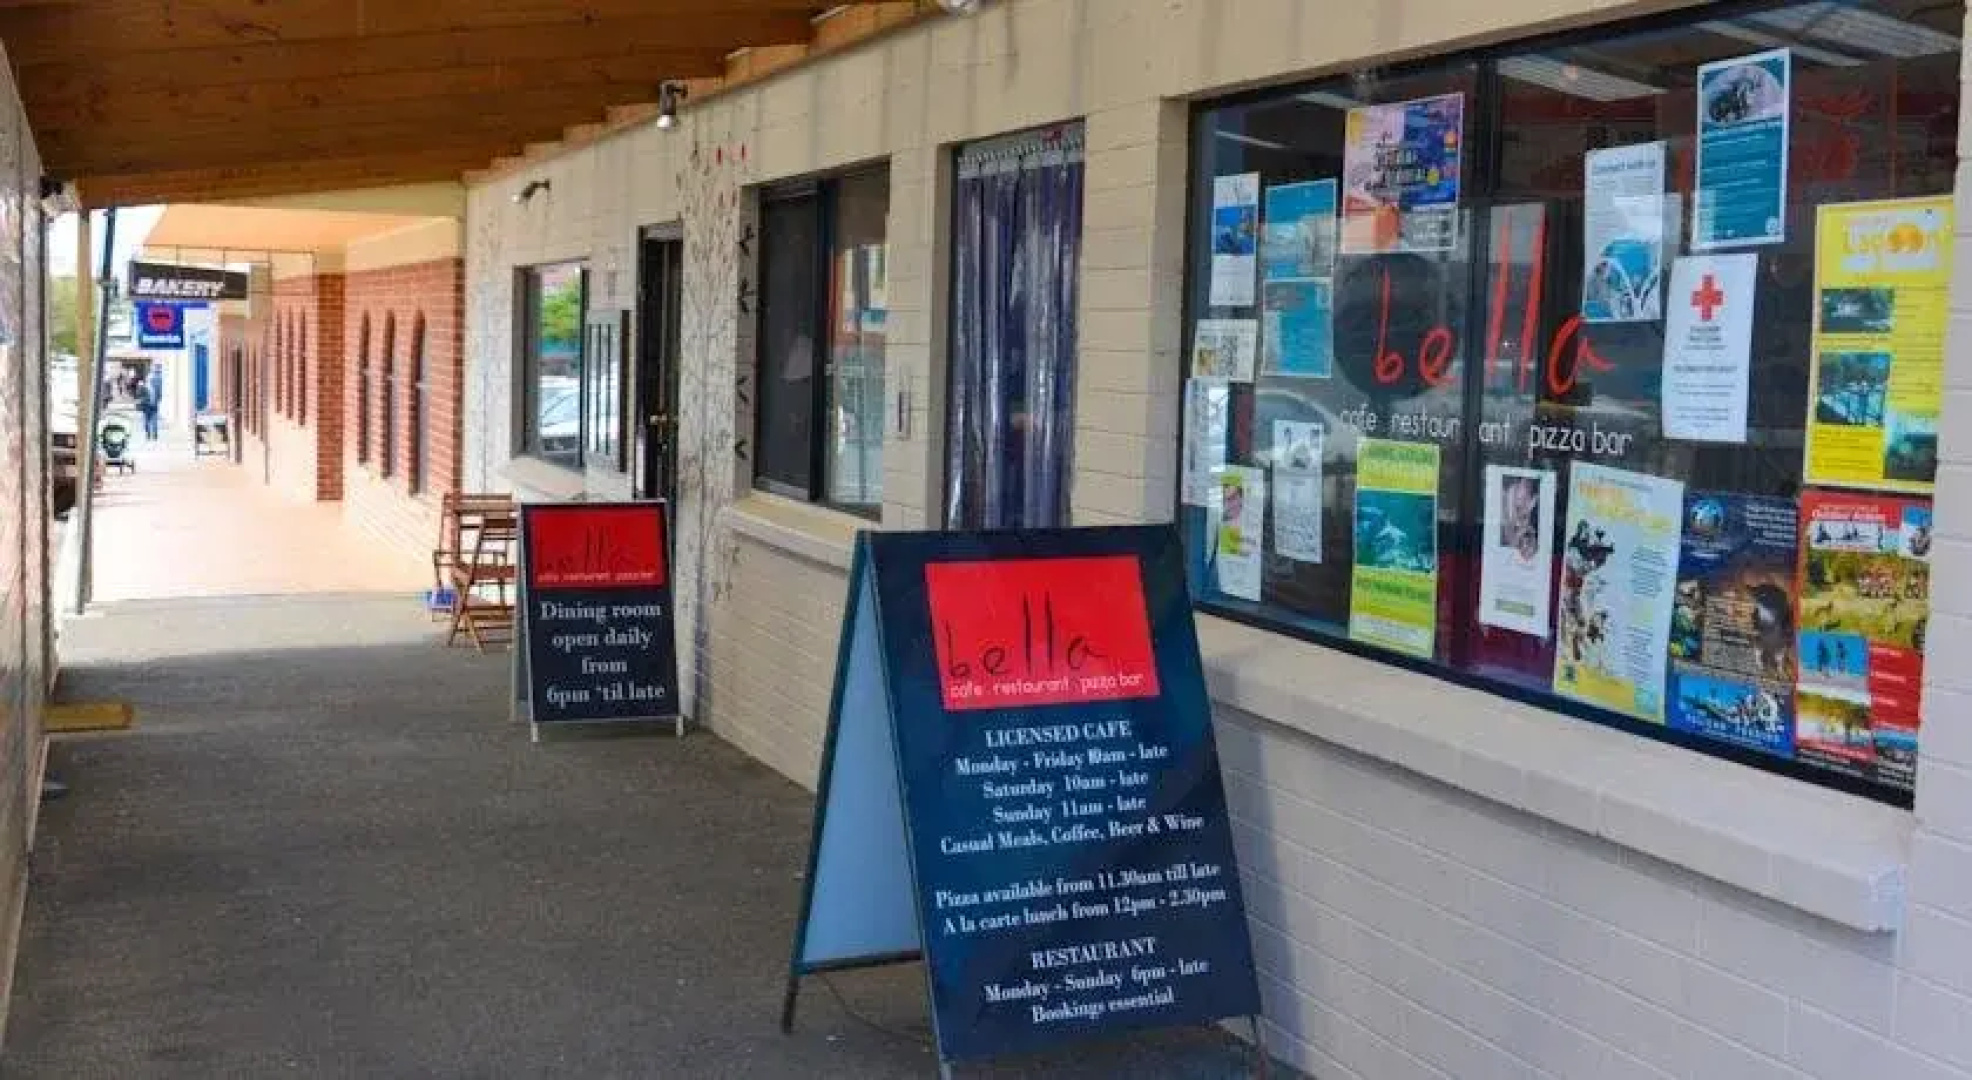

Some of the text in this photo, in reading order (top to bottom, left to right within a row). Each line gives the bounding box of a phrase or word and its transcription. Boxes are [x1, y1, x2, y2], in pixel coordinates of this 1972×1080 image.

[136, 277, 225, 297] BAKERY
[1373, 203, 1615, 396] bella
[1340, 405, 1377, 432] cafe
[1529, 423, 1584, 458] pizza
[1592, 422, 1633, 455] bar
[539, 602, 662, 624] Dining room
[552, 627, 653, 653] open daily
[946, 590, 1107, 677] bella
[581, 657, 628, 675] from
[546, 687, 590, 709] 6pm
[628, 681, 665, 700] late
[950, 682, 982, 699] cafe
[993, 677, 1069, 696] restaurant
[1119, 671, 1144, 687] bar
[985, 720, 1133, 748] LICENSED CAFE
[955, 755, 1018, 776] Monday
[1033, 750, 1083, 770] Friday
[1138, 743, 1168, 760] late
[983, 778, 1053, 799] Saturday
[1065, 774, 1106, 791] 10am
[1119, 770, 1149, 786] late
[993, 803, 1051, 824] Sunday
[1061, 800, 1104, 817] 11am
[1116, 795, 1147, 811] late
[940, 833, 994, 855] Casual
[998, 829, 1050, 849] Meals,
[1107, 820, 1143, 838] Beer
[1147, 816, 1161, 833] &
[1163, 813, 1203, 831] Wine
[936, 863, 1221, 909] Pizza available from 11.30am till late
[943, 918, 956, 935] A
[959, 915, 976, 933] la
[978, 912, 1020, 930] carte
[1023, 904, 1069, 925] lunch
[1072, 901, 1109, 919] from
[1113, 896, 1157, 917] 12pm
[1168, 888, 1227, 908] 2.30pm
[1030, 937, 1157, 970] RESTAURANT
[984, 979, 1050, 1002] Monday
[1064, 969, 1123, 991] Sunday
[1130, 965, 1166, 986] 6pm
[1178, 957, 1210, 976] late
[1032, 987, 1175, 1024] Bookings essential
